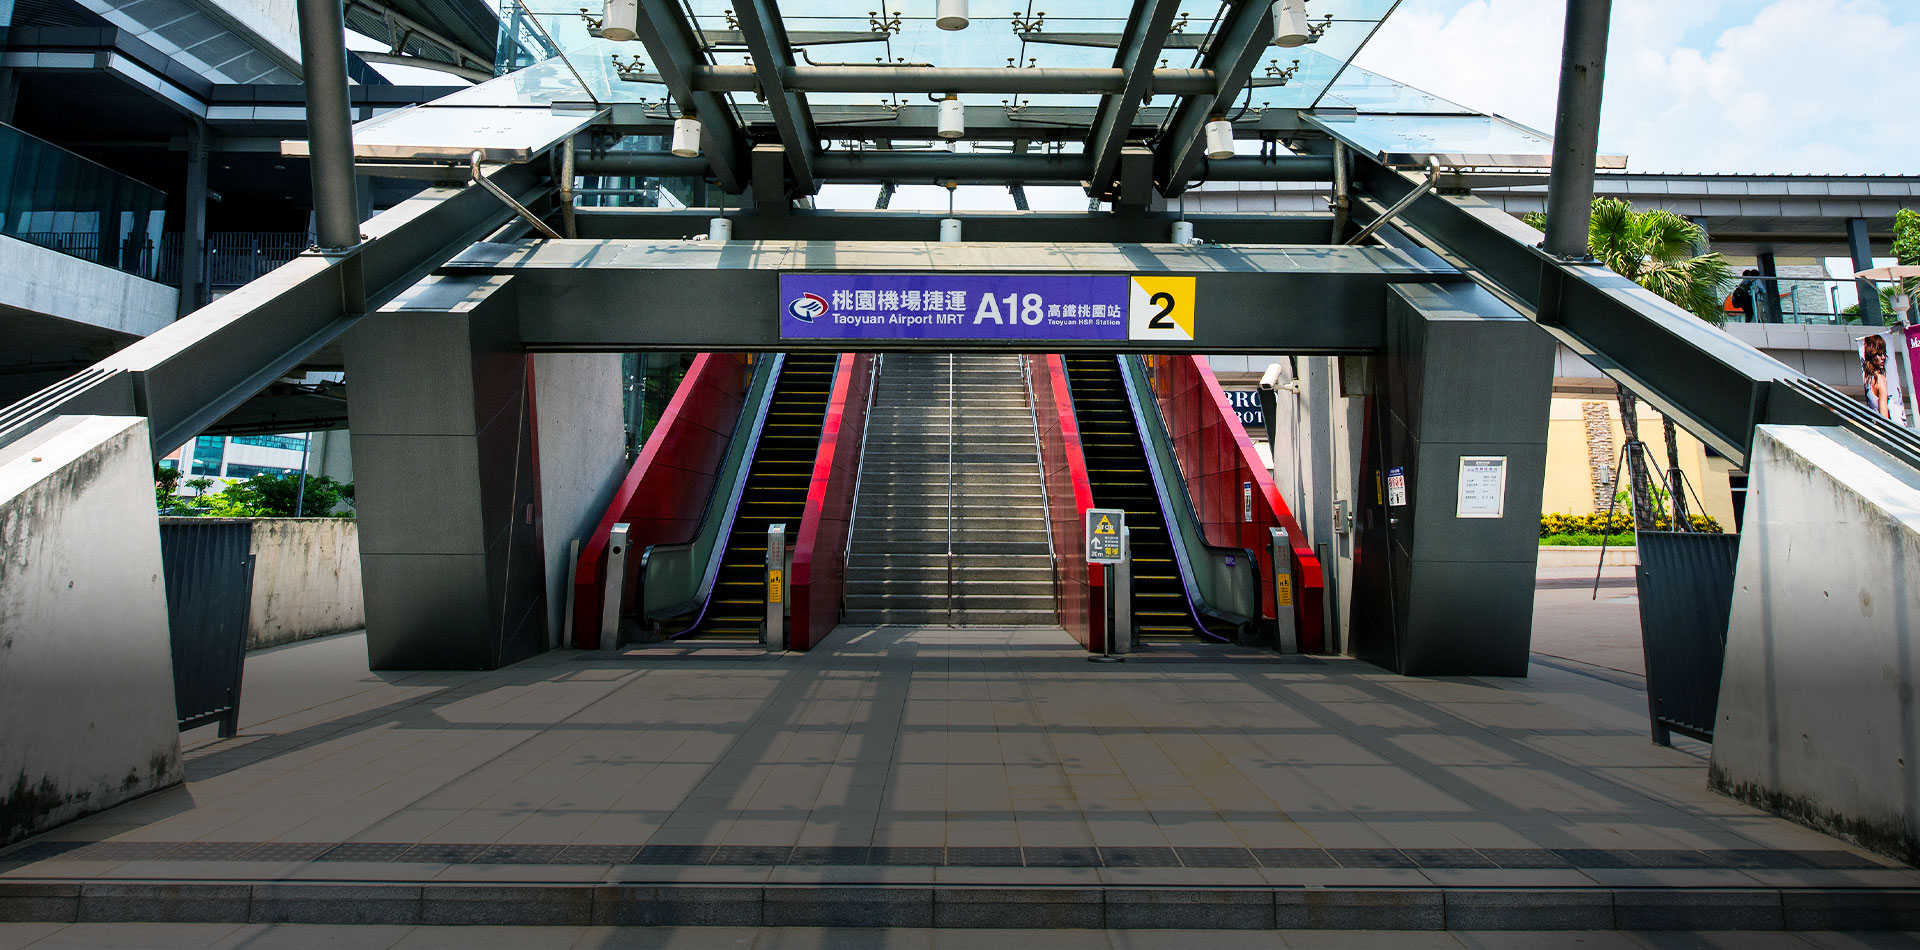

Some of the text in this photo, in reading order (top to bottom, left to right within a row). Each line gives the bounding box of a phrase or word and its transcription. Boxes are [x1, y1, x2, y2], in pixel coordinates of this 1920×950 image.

[832, 290, 967, 311] 桃園機場捷運
[973, 292, 1044, 326] A18
[1048, 304, 1121, 318] 高鐵桃園站
[1148, 292, 1176, 329] 2
[832, 313, 965, 326] Taoyuan Airport MRT
[1048, 318, 1077, 326] Taoyuan
[1095, 318, 1121, 326] Station
[1223, 391, 1279, 407] BRO
